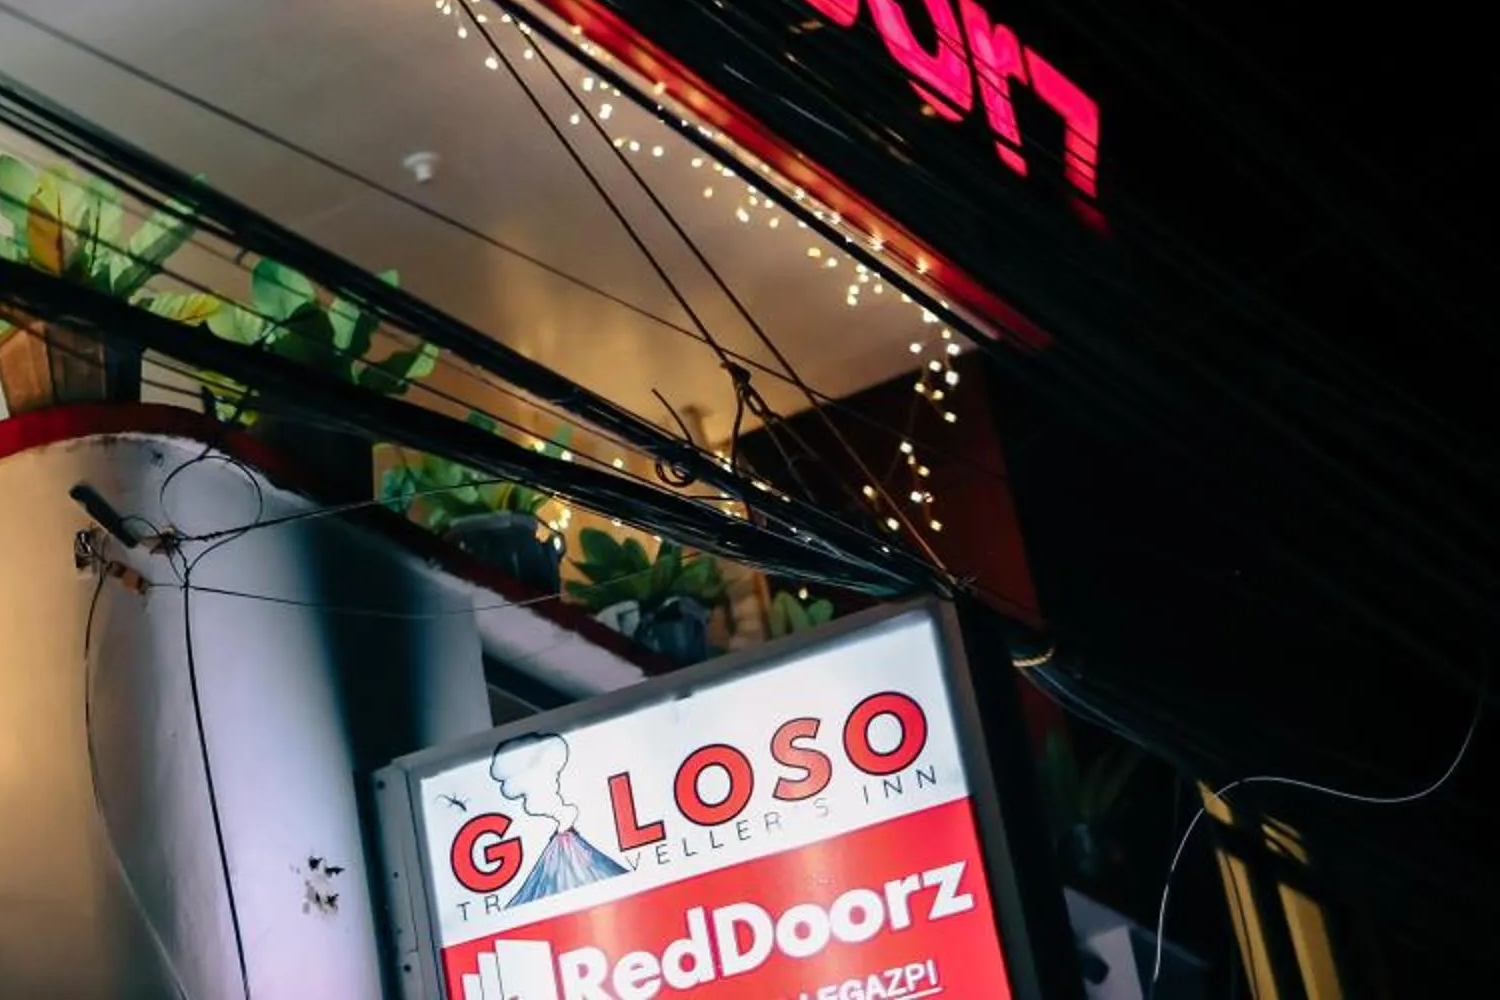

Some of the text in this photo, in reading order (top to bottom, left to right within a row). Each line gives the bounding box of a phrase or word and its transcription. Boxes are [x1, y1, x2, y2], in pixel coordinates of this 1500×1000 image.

[862, 765, 937, 804] INN
[558, 860, 974, 1000] RedDoorz
[799, 959, 939, 1000] EGAZPI
